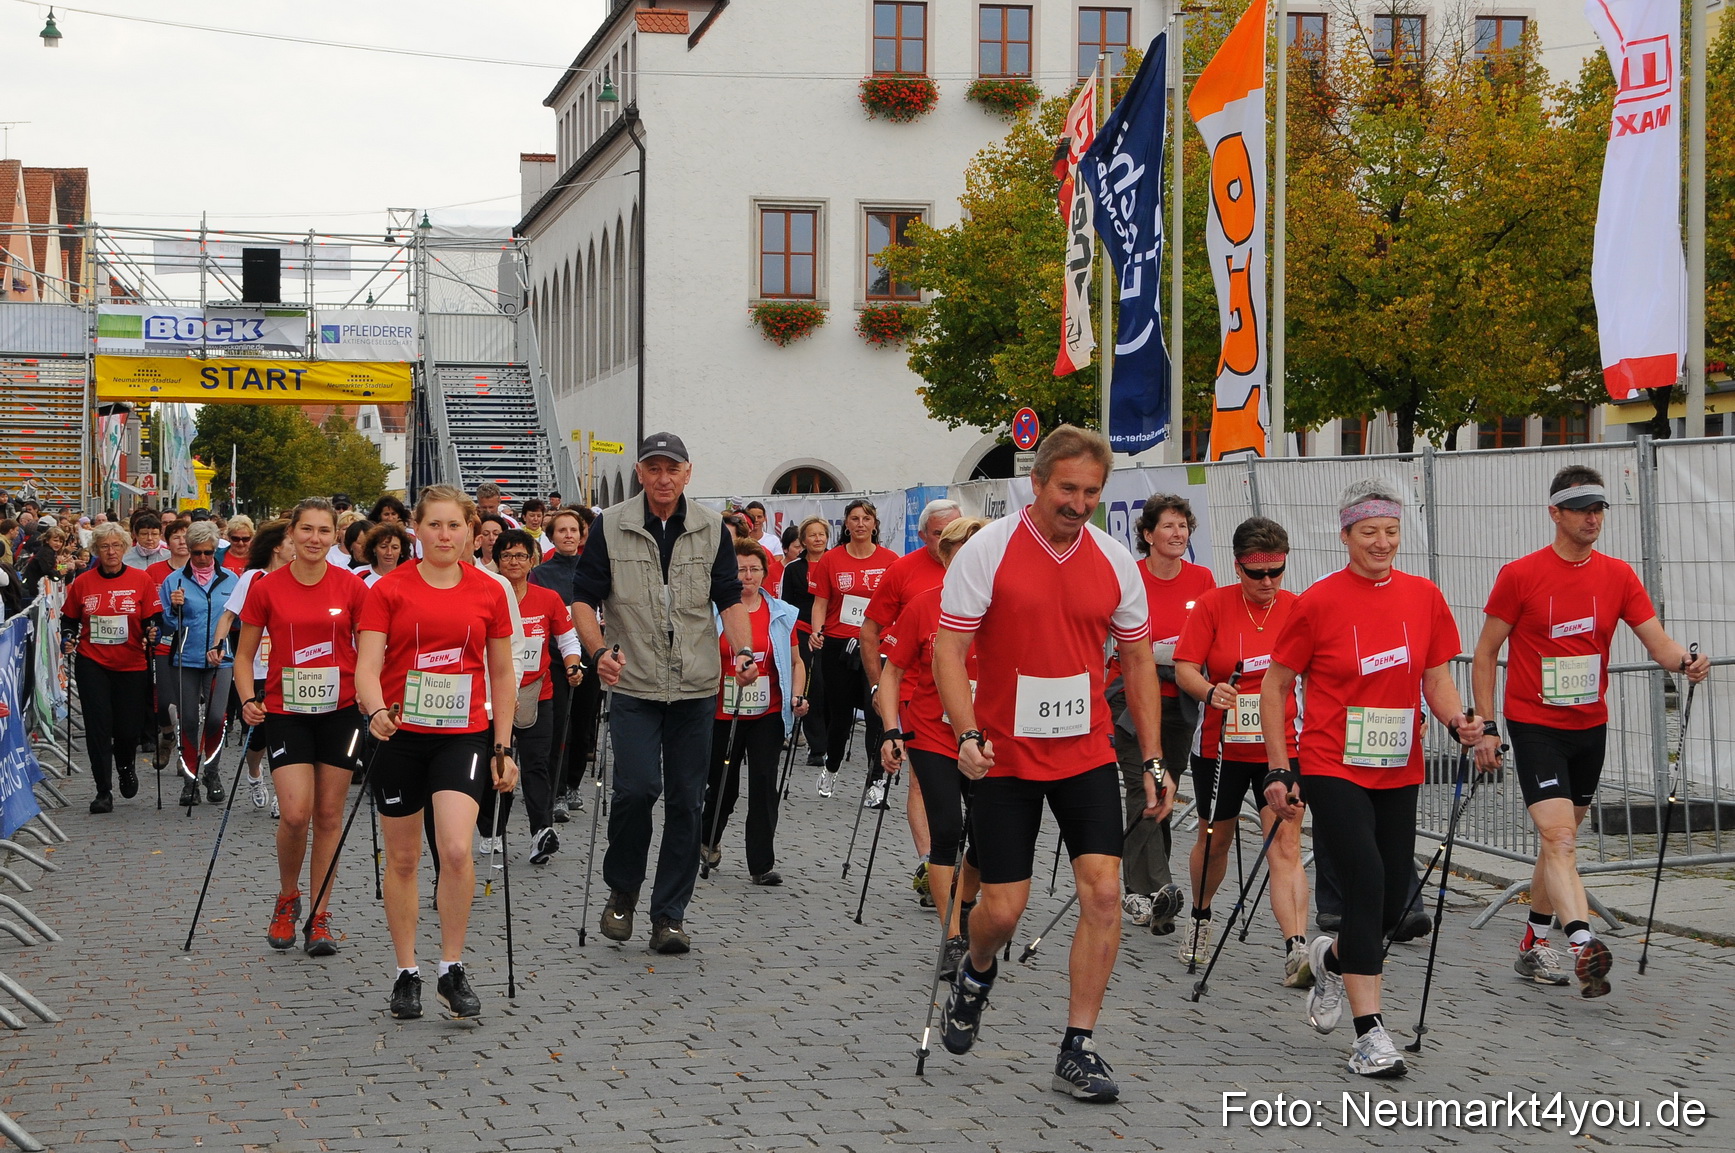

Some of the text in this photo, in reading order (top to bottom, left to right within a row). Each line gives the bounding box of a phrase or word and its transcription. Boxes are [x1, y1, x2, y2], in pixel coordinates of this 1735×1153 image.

[145, 316, 266, 342] BOCK
[343, 325, 413, 338] PFLEIDERER
[200, 366, 308, 391] START
[100, 626, 125, 635] 8078
[1563, 623, 1583, 633] DEHN
[305, 647, 323, 658] DEHN
[430, 653, 450, 663] DEHN
[523, 650, 538, 660] 07
[1374, 654, 1395, 667] DEHN
[1559, 660, 1589, 671] Richard
[297, 671, 323, 680] Carina
[1561, 673, 1596, 690] 8089
[424, 676, 451, 689] Nicole
[298, 684, 335, 698] 8057
[423, 693, 465, 710] 8088
[1039, 698, 1085, 718] 8113
[1239, 697, 1260, 709] Brigi
[1241, 713, 1260, 727] 80
[1367, 711, 1406, 724] Marianne
[1367, 730, 1407, 748] 8083
